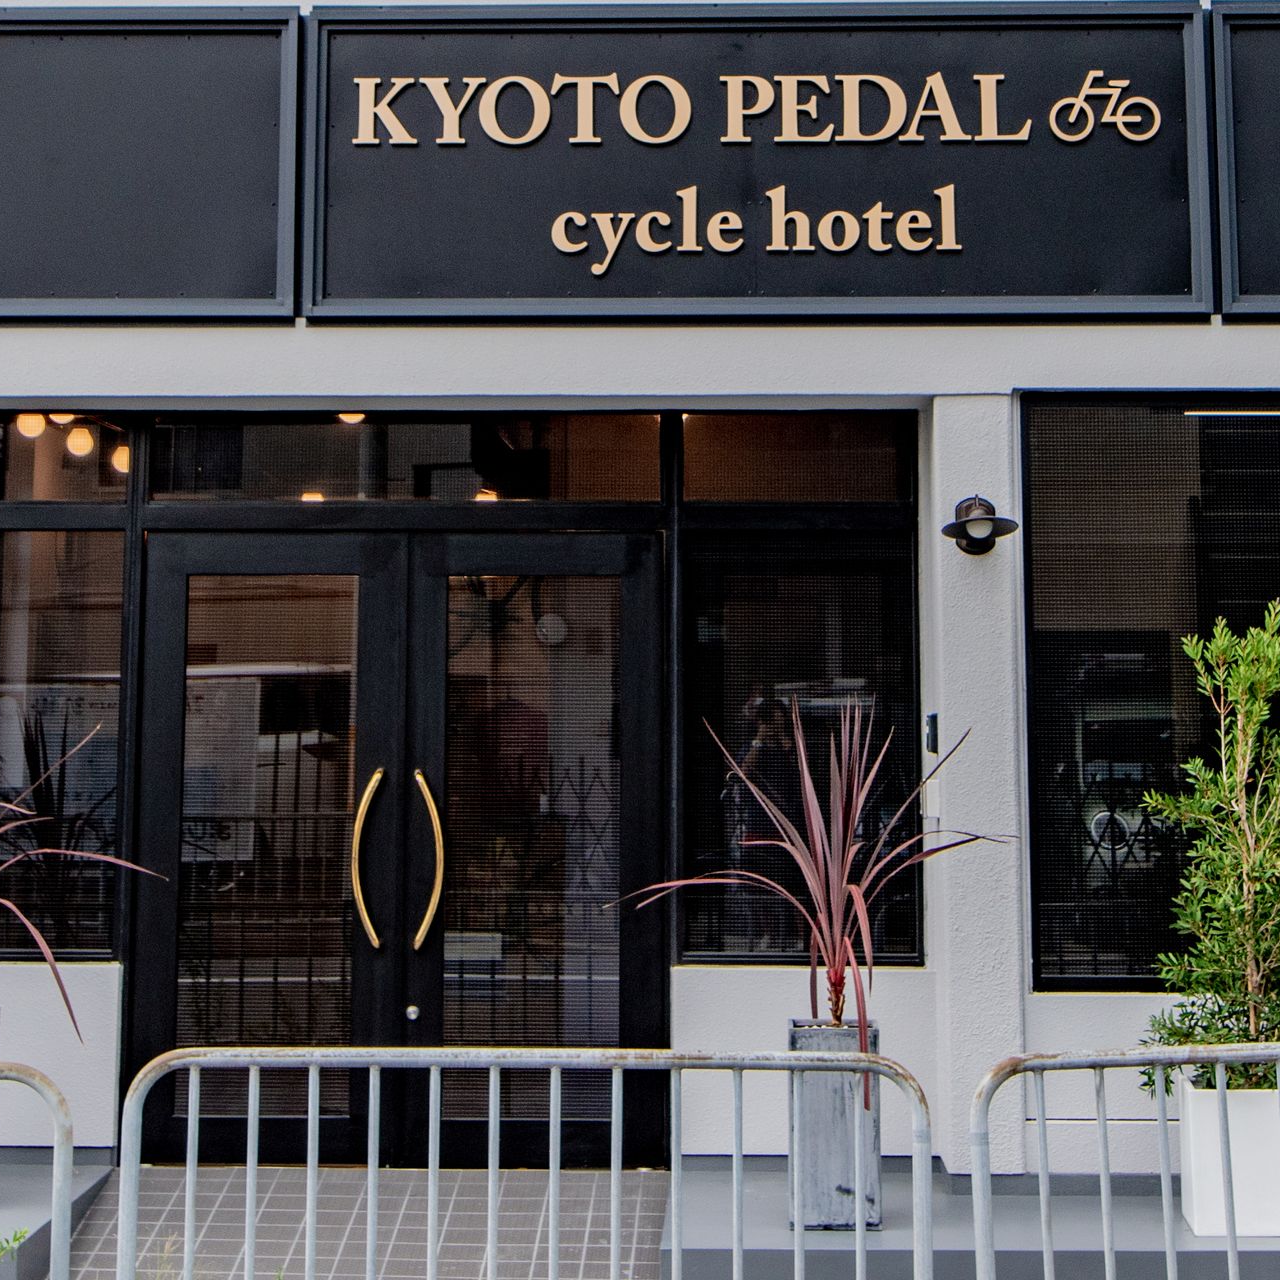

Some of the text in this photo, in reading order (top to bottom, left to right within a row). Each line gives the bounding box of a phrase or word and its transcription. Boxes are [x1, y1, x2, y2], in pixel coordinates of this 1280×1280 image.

[351, 71, 1033, 145] KYOTO PEDAL
[549, 183, 963, 276] cycle hotel
